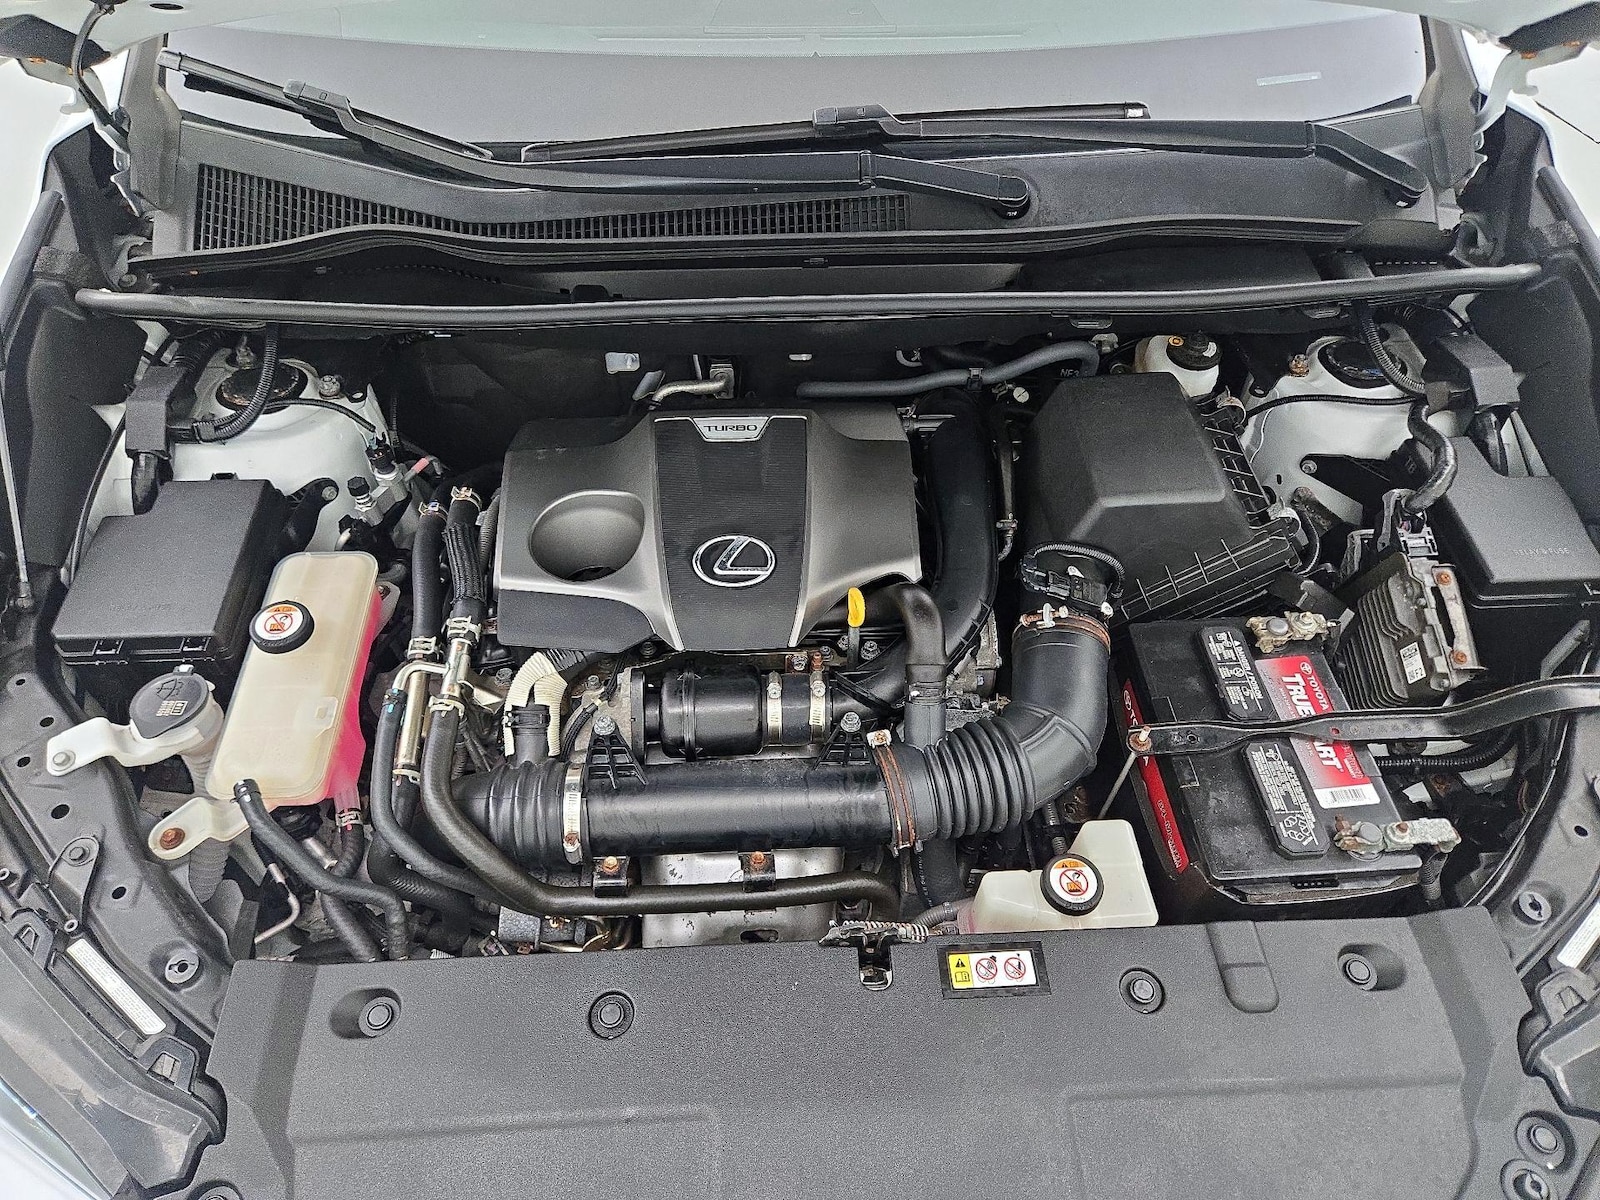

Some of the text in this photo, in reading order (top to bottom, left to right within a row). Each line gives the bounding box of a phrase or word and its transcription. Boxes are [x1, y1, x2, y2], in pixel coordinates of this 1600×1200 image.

[703, 424, 758, 432] TURBO
[1236, 646, 1251, 671] DANGER
[1248, 675, 1264, 699] POISON
[1307, 675, 1330, 711] TOYOTA
